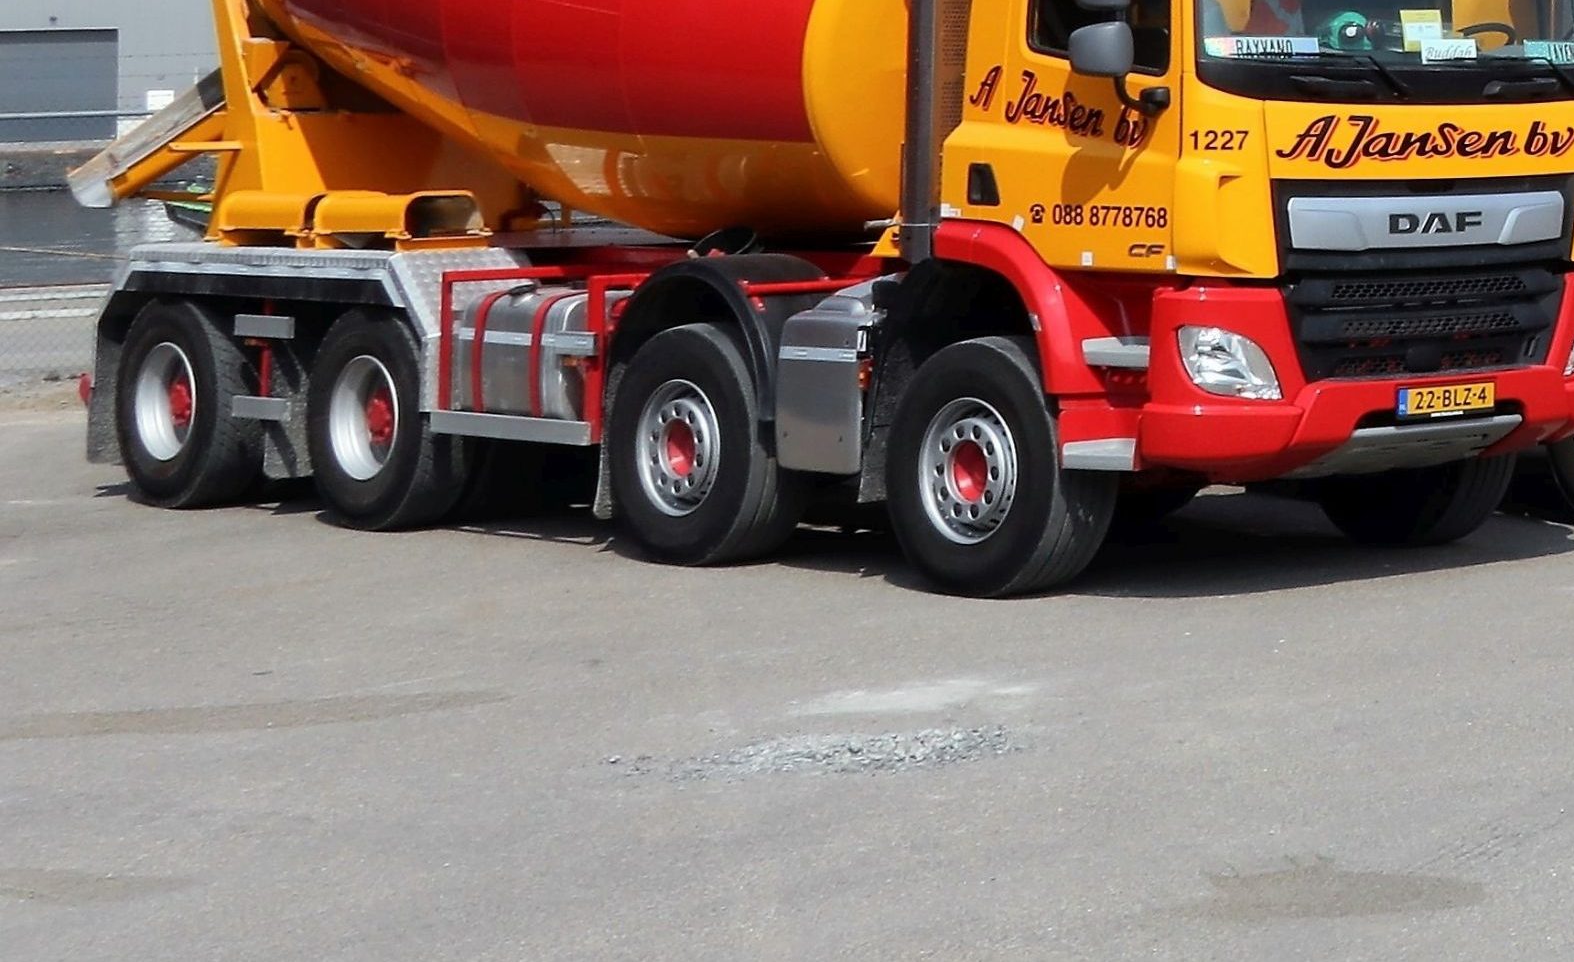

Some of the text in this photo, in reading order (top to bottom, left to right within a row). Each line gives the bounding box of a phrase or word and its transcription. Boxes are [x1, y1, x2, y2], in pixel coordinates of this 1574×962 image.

[970, 65, 1148, 150] A Jansen bv
[1189, 129, 1249, 151] 1227
[1325, 115, 1522, 169] Jansen
[1052, 204, 1168, 228] 088 8778768
[1388, 211, 1482, 235] DAF
[1128, 243, 1165, 257] CF
[1415, 387, 1487, 410] 22-BLZ-4
